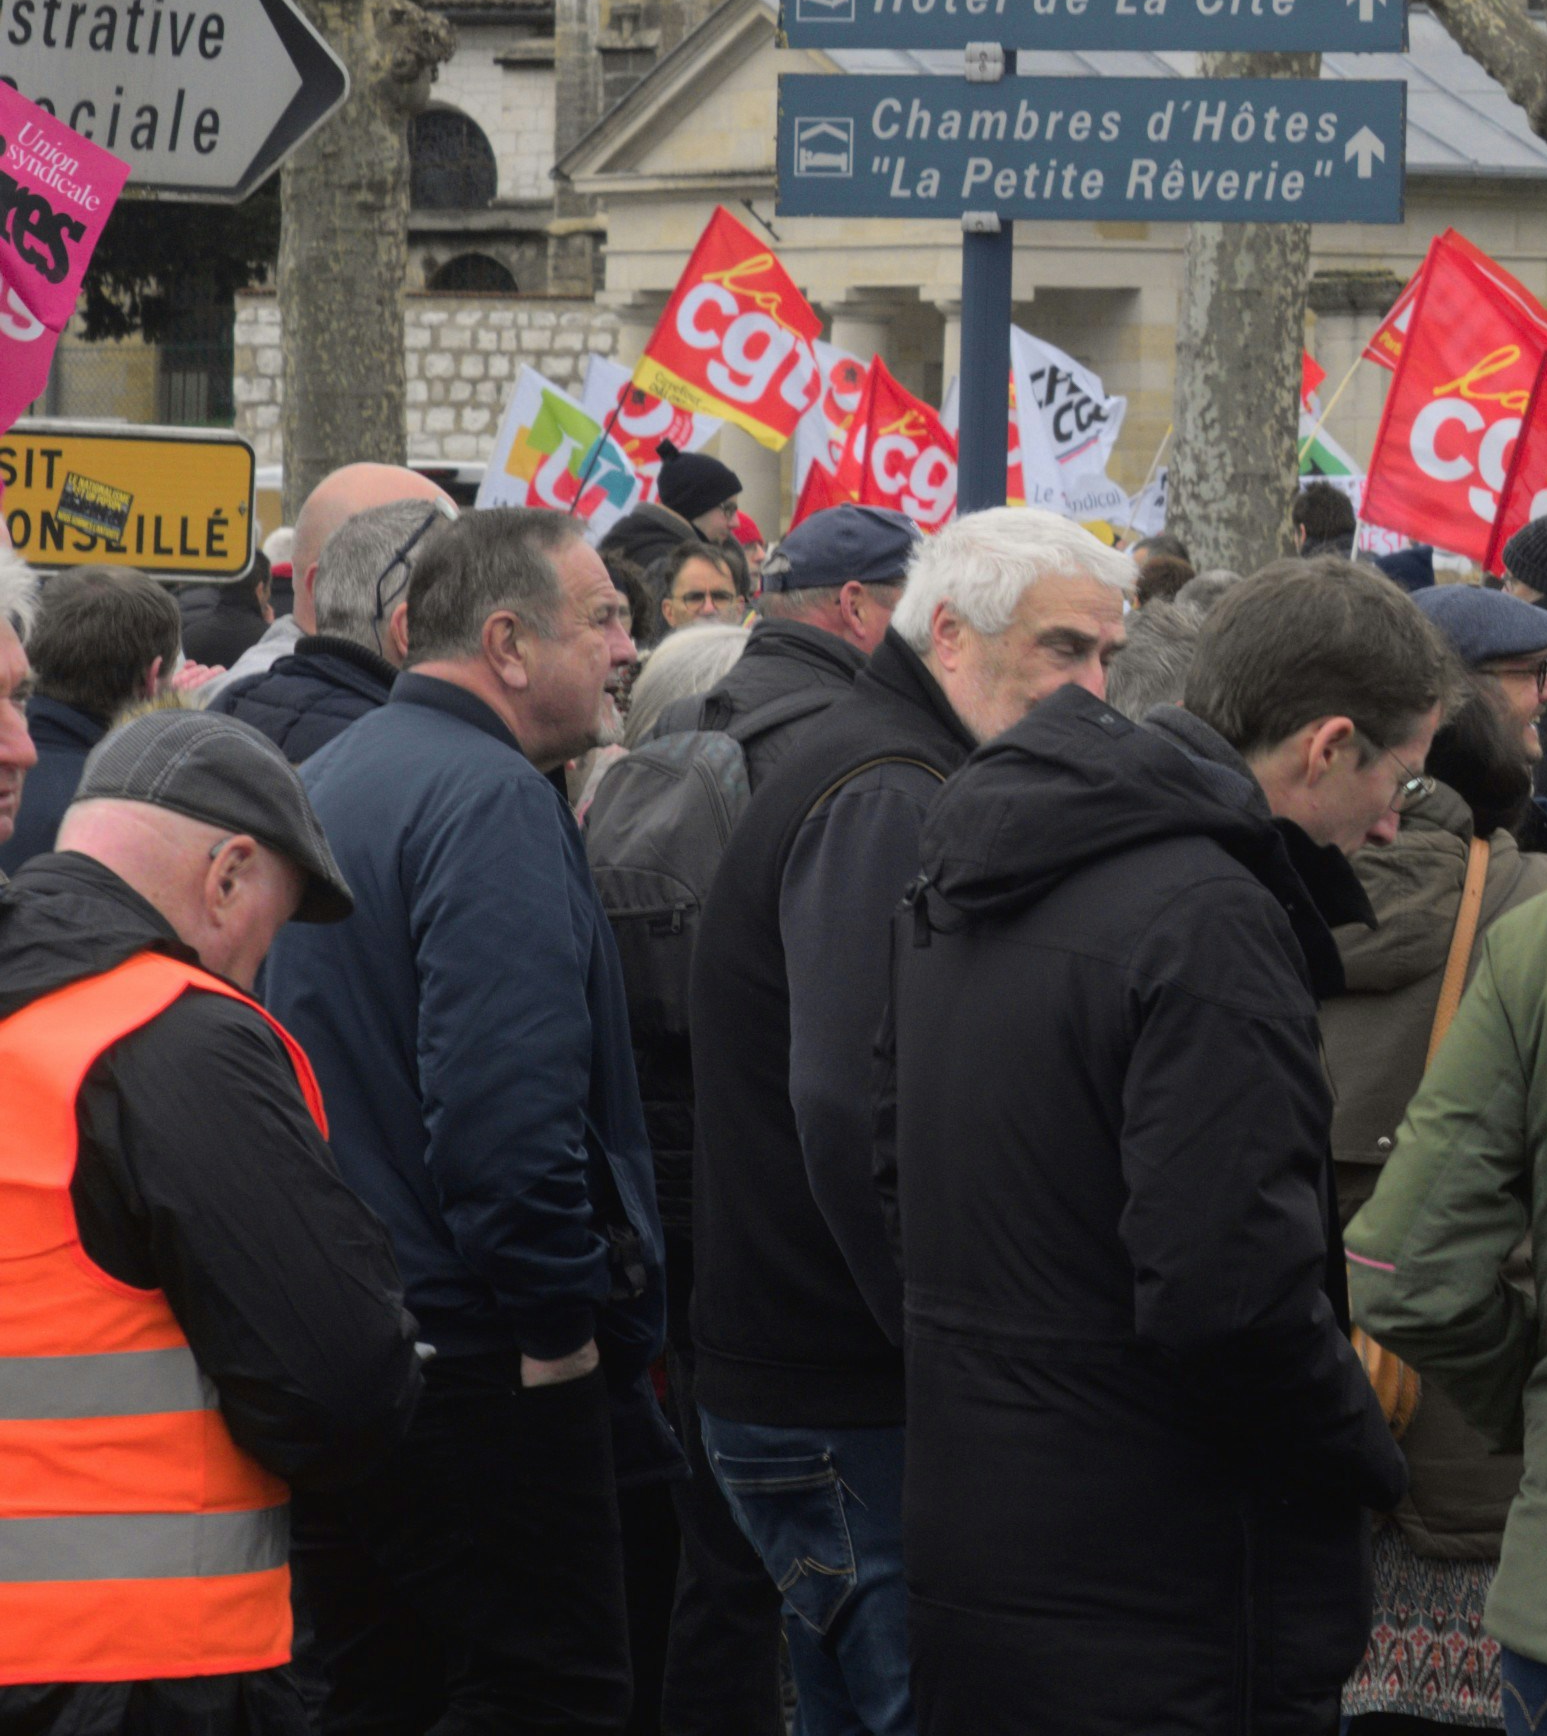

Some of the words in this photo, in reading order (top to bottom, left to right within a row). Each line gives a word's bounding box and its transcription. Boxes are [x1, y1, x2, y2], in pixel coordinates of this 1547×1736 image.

[872, 97, 1121, 141] Chambres
[1146, 100, 1338, 143] d'Hôtes
[17, 121, 80, 177] Union
[6, 144, 101, 212] syndicale
[872, 156, 938, 199] "La
[961, 157, 1104, 200] Petite
[1126, 158, 1333, 202] Rêverie"
